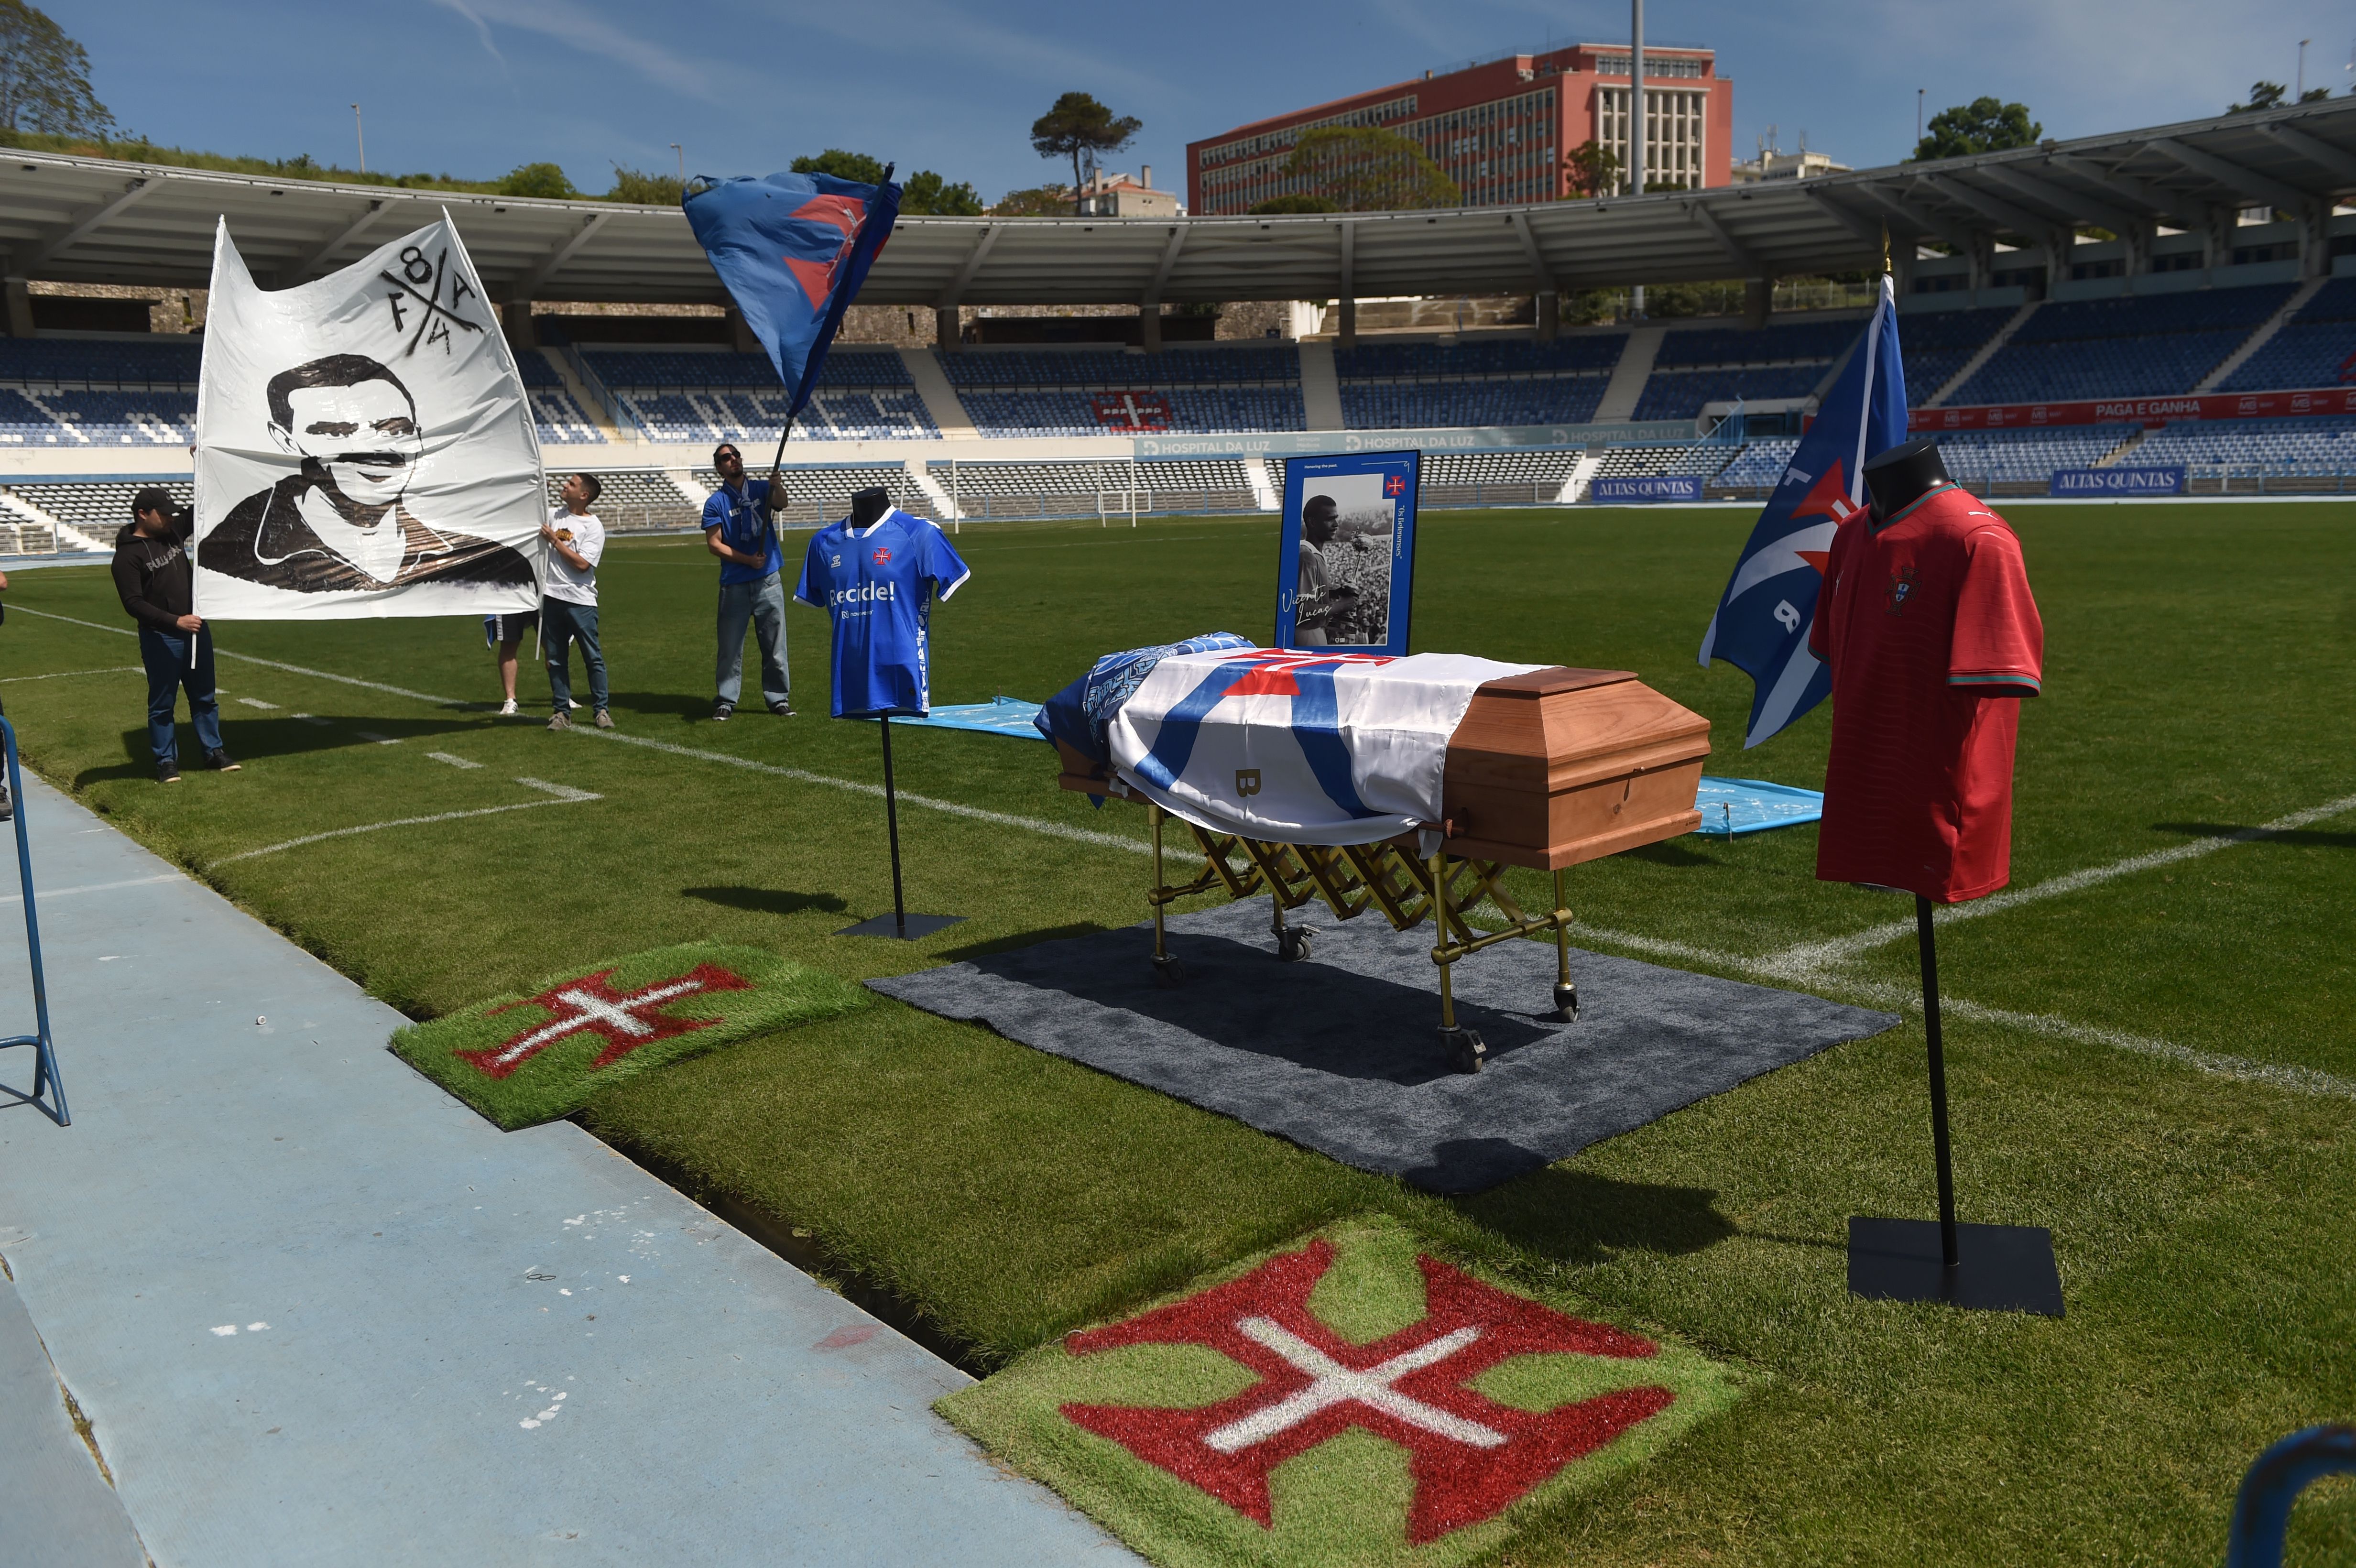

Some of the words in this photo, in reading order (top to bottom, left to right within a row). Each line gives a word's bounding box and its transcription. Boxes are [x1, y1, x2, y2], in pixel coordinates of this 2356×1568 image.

[401, 246, 432, 284] 8
[454, 271, 476, 309] A
[388, 292, 407, 332] F
[427, 317, 450, 355] 4
[2096, 403, 2134, 416] PAGA
[2137, 403, 2146, 415] E
[2149, 401, 2201, 414] GANHA
[1162, 442, 1222, 455] HOSPITAL
[1226, 441, 1243, 452] DA
[1247, 441, 1271, 452] LUZ
[1364, 436, 1426, 449] HOSPITAL
[1429, 436, 1447, 447] DA
[1450, 436, 1475, 446] LUZ
[1571, 431, 1633, 443] HOSPITAL
[1637, 430, 1656, 440] DA
[1661, 428, 1686, 439] LUZ
[1599, 482, 1636, 496] ALTAS
[1638, 481, 1694, 496] QUINTAS
[2059, 473, 2105, 490] ALTAS
[2106, 471, 2175, 490] QUINTAS
[830, 581, 894, 607] Recicle!
[1283, 585, 1326, 612] Vicente
[1296, 602, 1332, 626] Lucas
[1235, 769, 1262, 798] B
